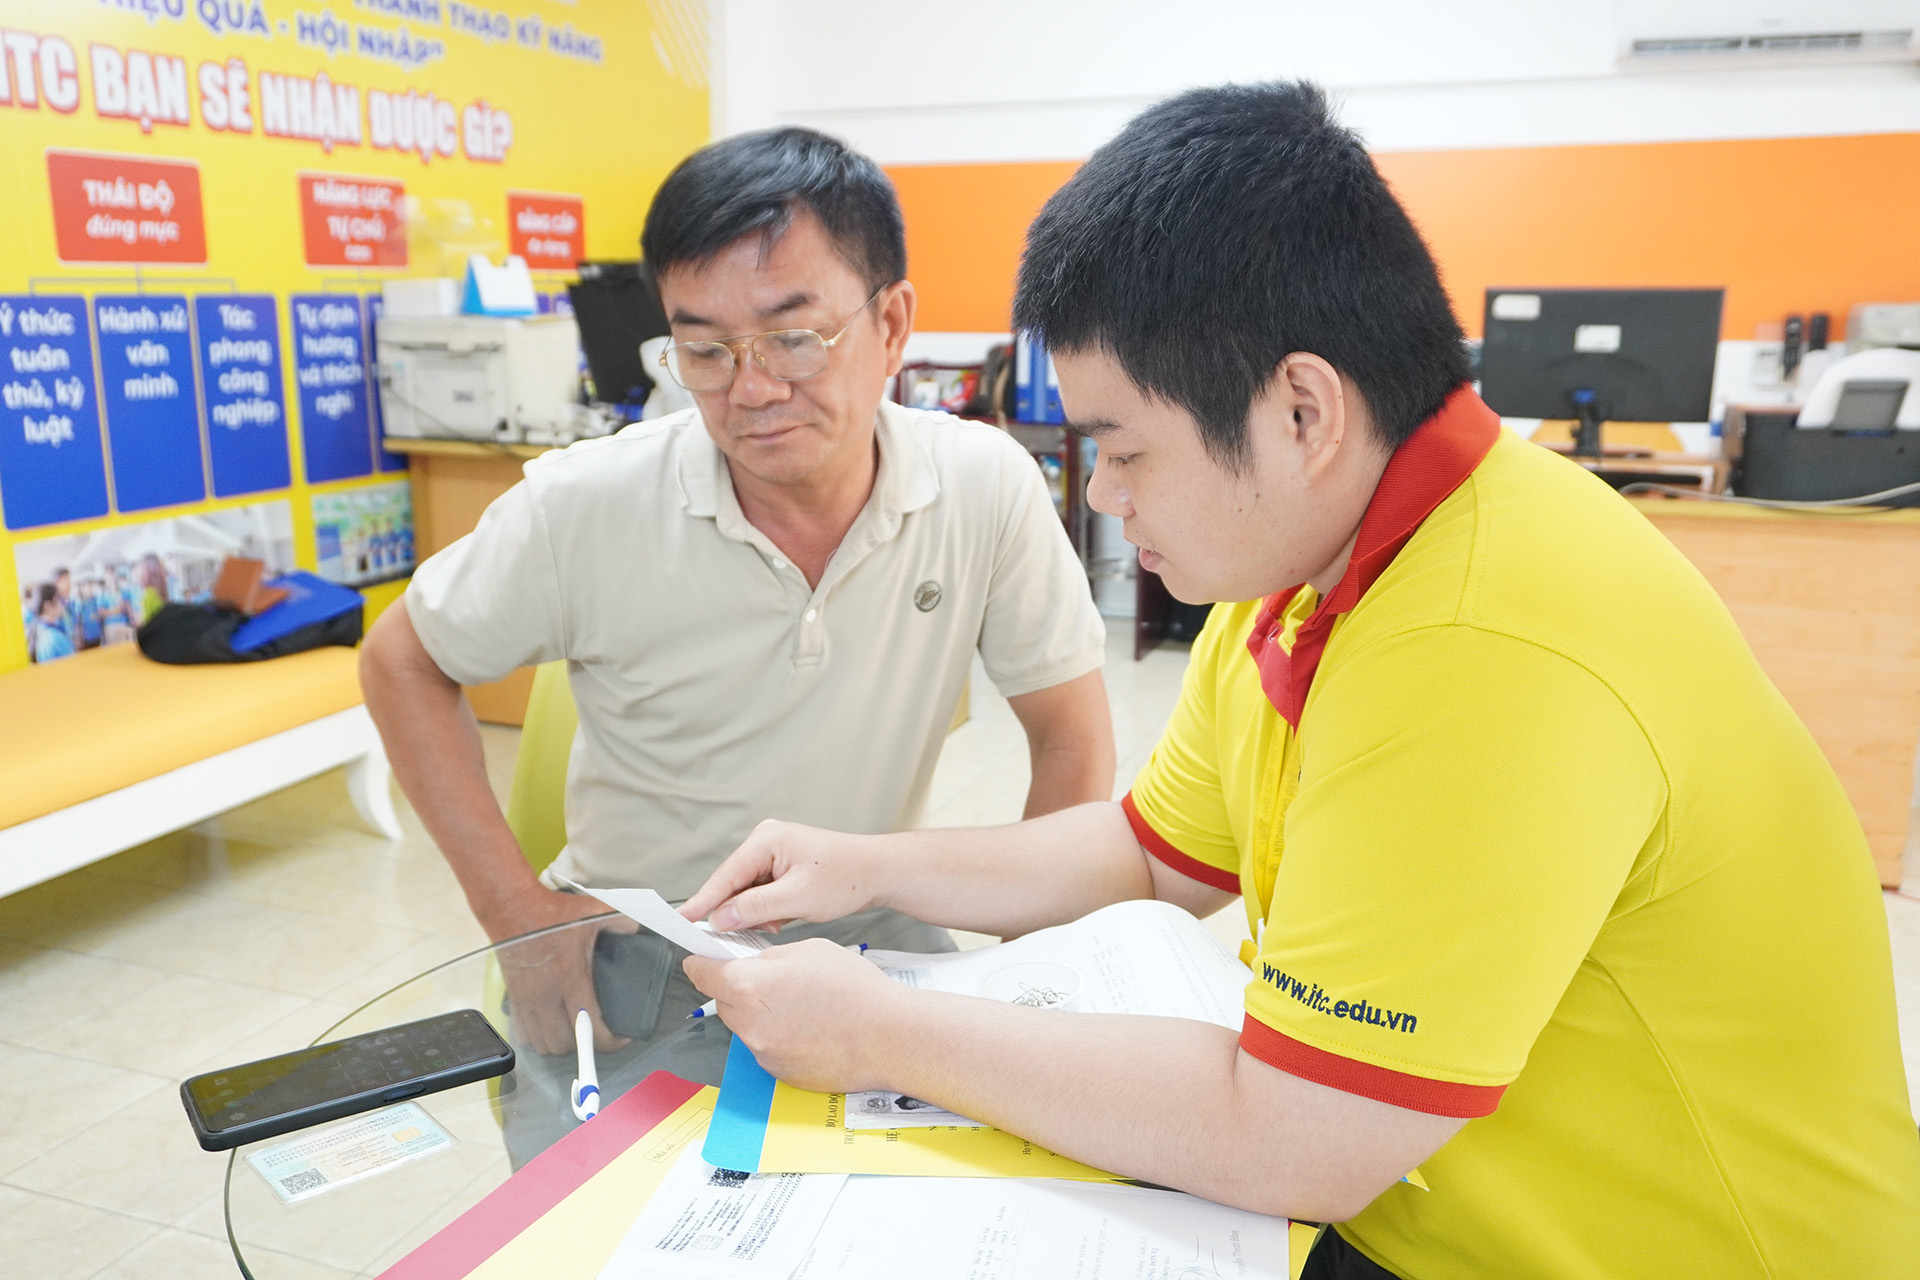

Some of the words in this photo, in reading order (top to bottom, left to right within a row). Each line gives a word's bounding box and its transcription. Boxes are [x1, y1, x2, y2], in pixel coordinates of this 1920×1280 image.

[89, 42, 190, 134] BẠN
[199, 57, 253, 134] SẼ
[258, 70, 362, 154] NHẬN
[367, 88, 458, 163] ĐƯỢC
[82, 176, 138, 209] THÁI
[138, 179, 175, 217] ĐỘ
[86, 213, 138, 244] đúng
[18, 306, 77, 337] thức
[98, 305, 159, 335] Hành
[218, 304, 257, 331] Tác
[10, 342, 71, 373] tuân
[208, 336, 273, 369] phong
[124, 371, 179, 400] minh
[218, 366, 270, 397] công
[23, 414, 76, 449] luật
[1262, 961, 1418, 1034] www.itc.edu.vn
[827, 1105, 838, 1118] LAO
